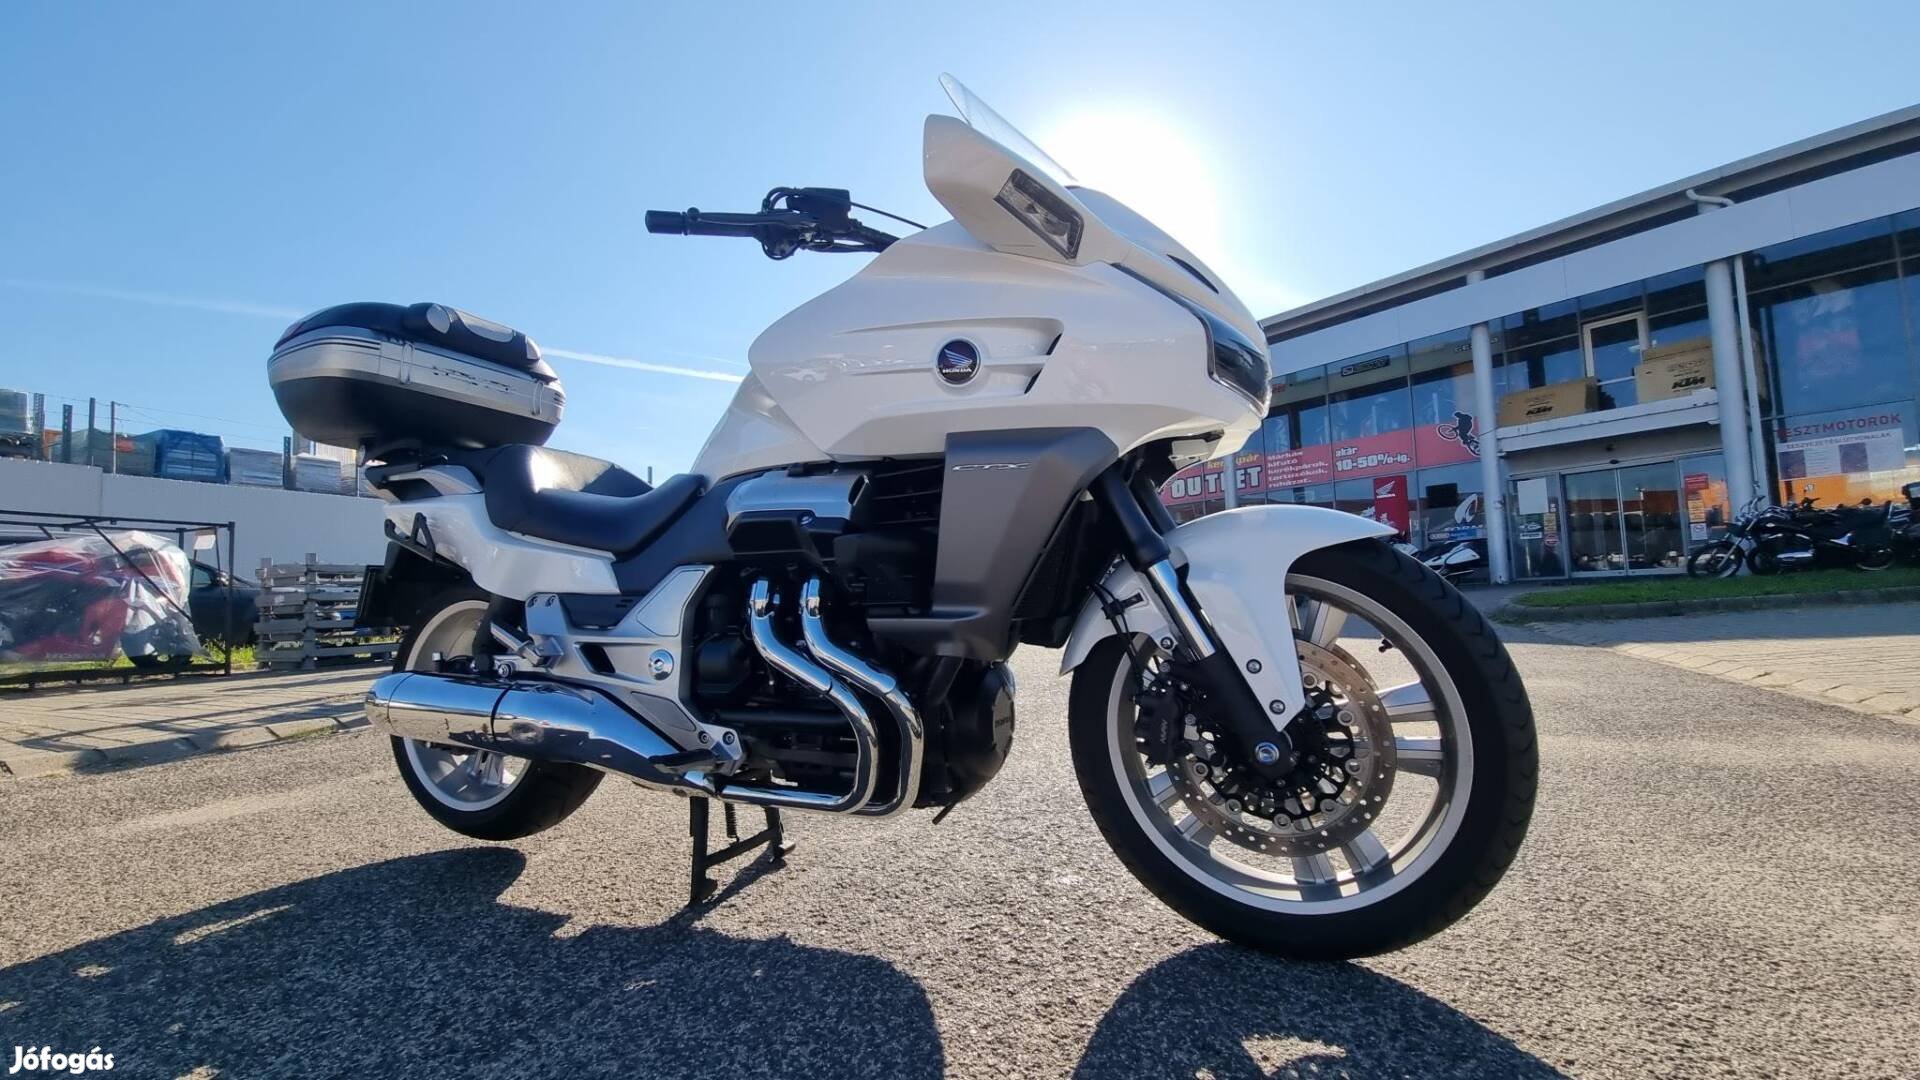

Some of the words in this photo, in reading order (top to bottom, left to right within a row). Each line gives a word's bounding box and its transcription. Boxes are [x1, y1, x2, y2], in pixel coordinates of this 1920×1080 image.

[1672, 376, 1706, 390] KTM
[952, 462, 1032, 471] CTX
[1336, 453, 1411, 472] 10-50%-ig.
